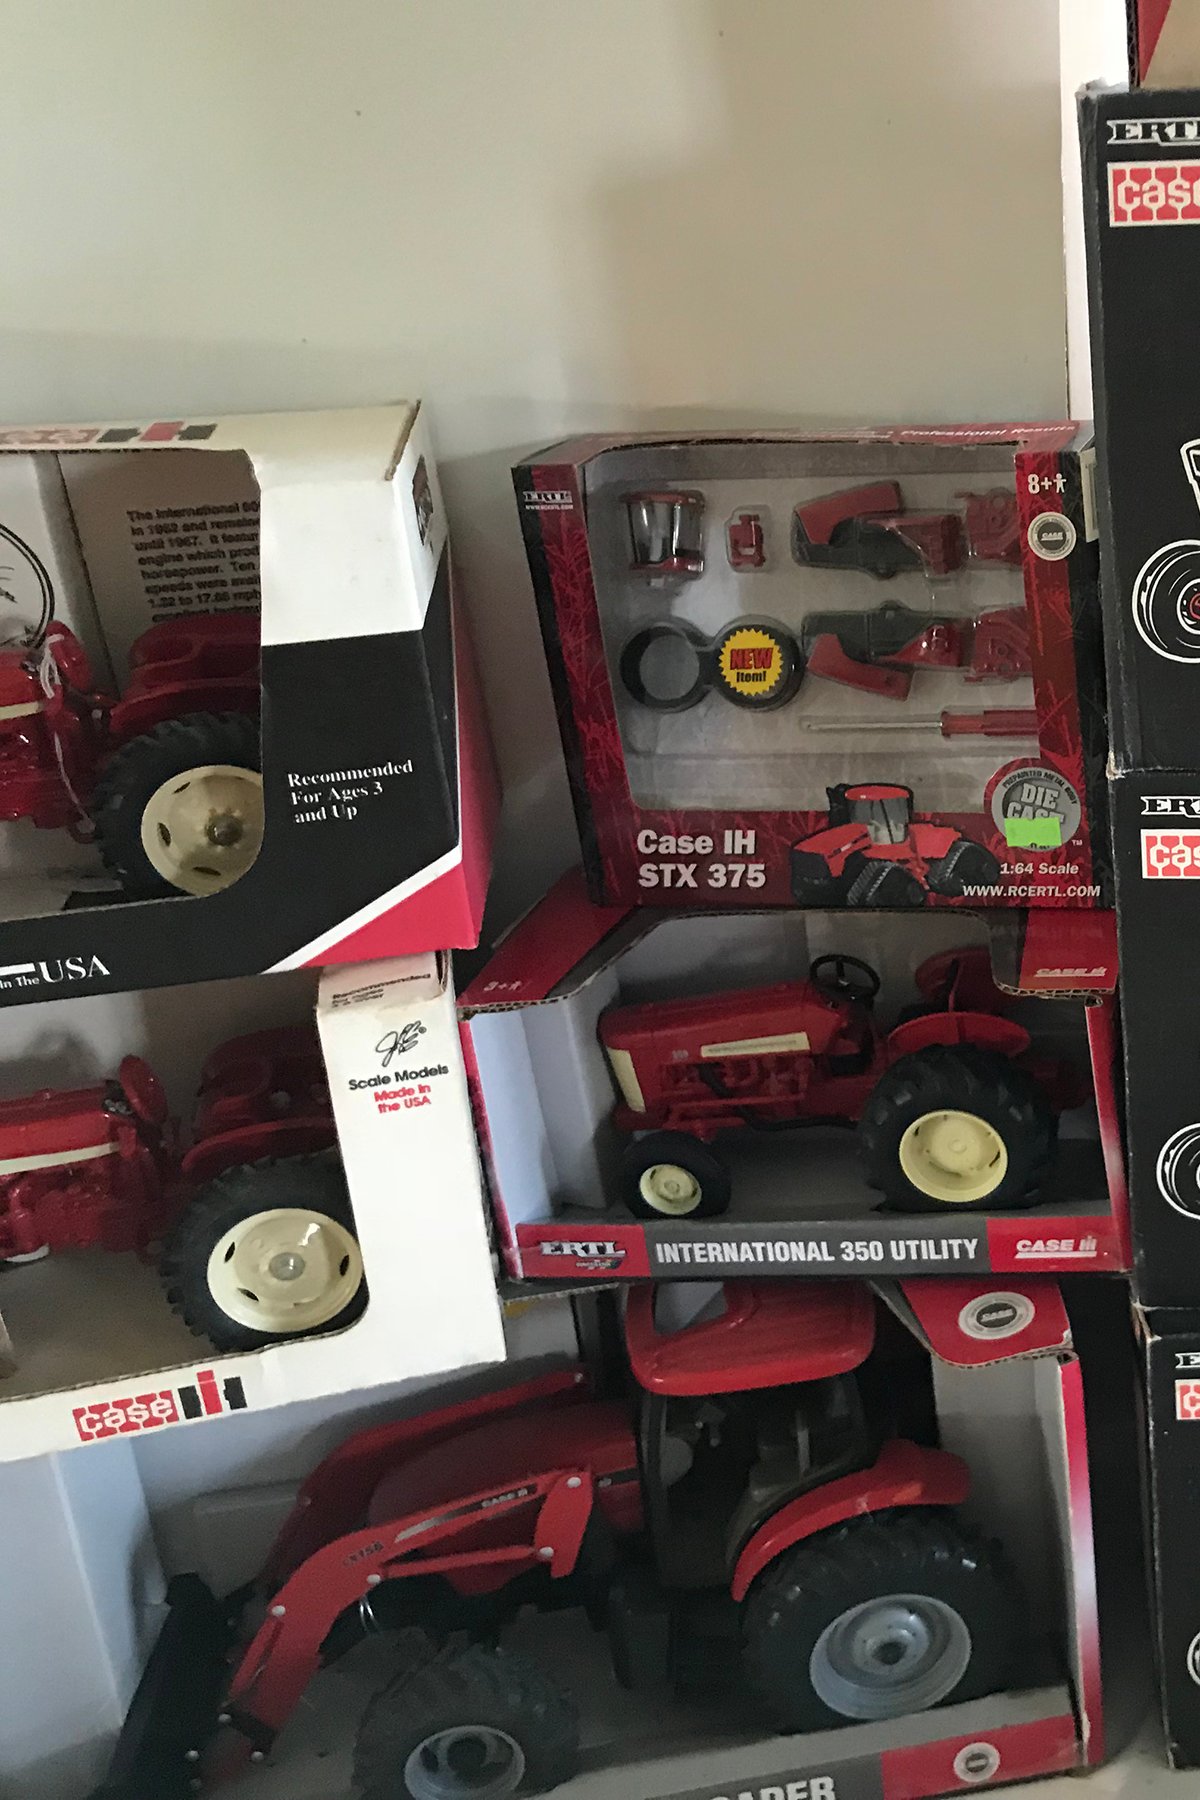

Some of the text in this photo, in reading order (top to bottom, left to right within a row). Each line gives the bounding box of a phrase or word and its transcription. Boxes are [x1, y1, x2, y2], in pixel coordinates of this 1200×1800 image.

[730, 648, 773, 670] NEW
[736, 671, 766, 683] Item!
[287, 759, 413, 788] Recommended
[291, 780, 383, 806] For Ages 3
[1021, 783, 1059, 809] DIE
[294, 803, 358, 823] and Up
[637, 829, 756, 854] Case IH
[638, 863, 766, 888] STX 375
[1000, 862, 1079, 875] 1:64 Scale
[963, 884, 1101, 897] WWW.RCERTL.COM
[15, 975, 40, 988] The
[38, 955, 111, 983] USA
[349, 1063, 449, 1090] Scale Models
[374, 1085, 415, 1102] Made
[378, 1095, 431, 1114] the USA
[540, 1241, 626, 1258] ERTL
[656, 1238, 978, 1263] INTERNATIONAL 350 UTILITY
[1016, 1239, 1075, 1252] CASE
[75, 1393, 177, 1438] case
